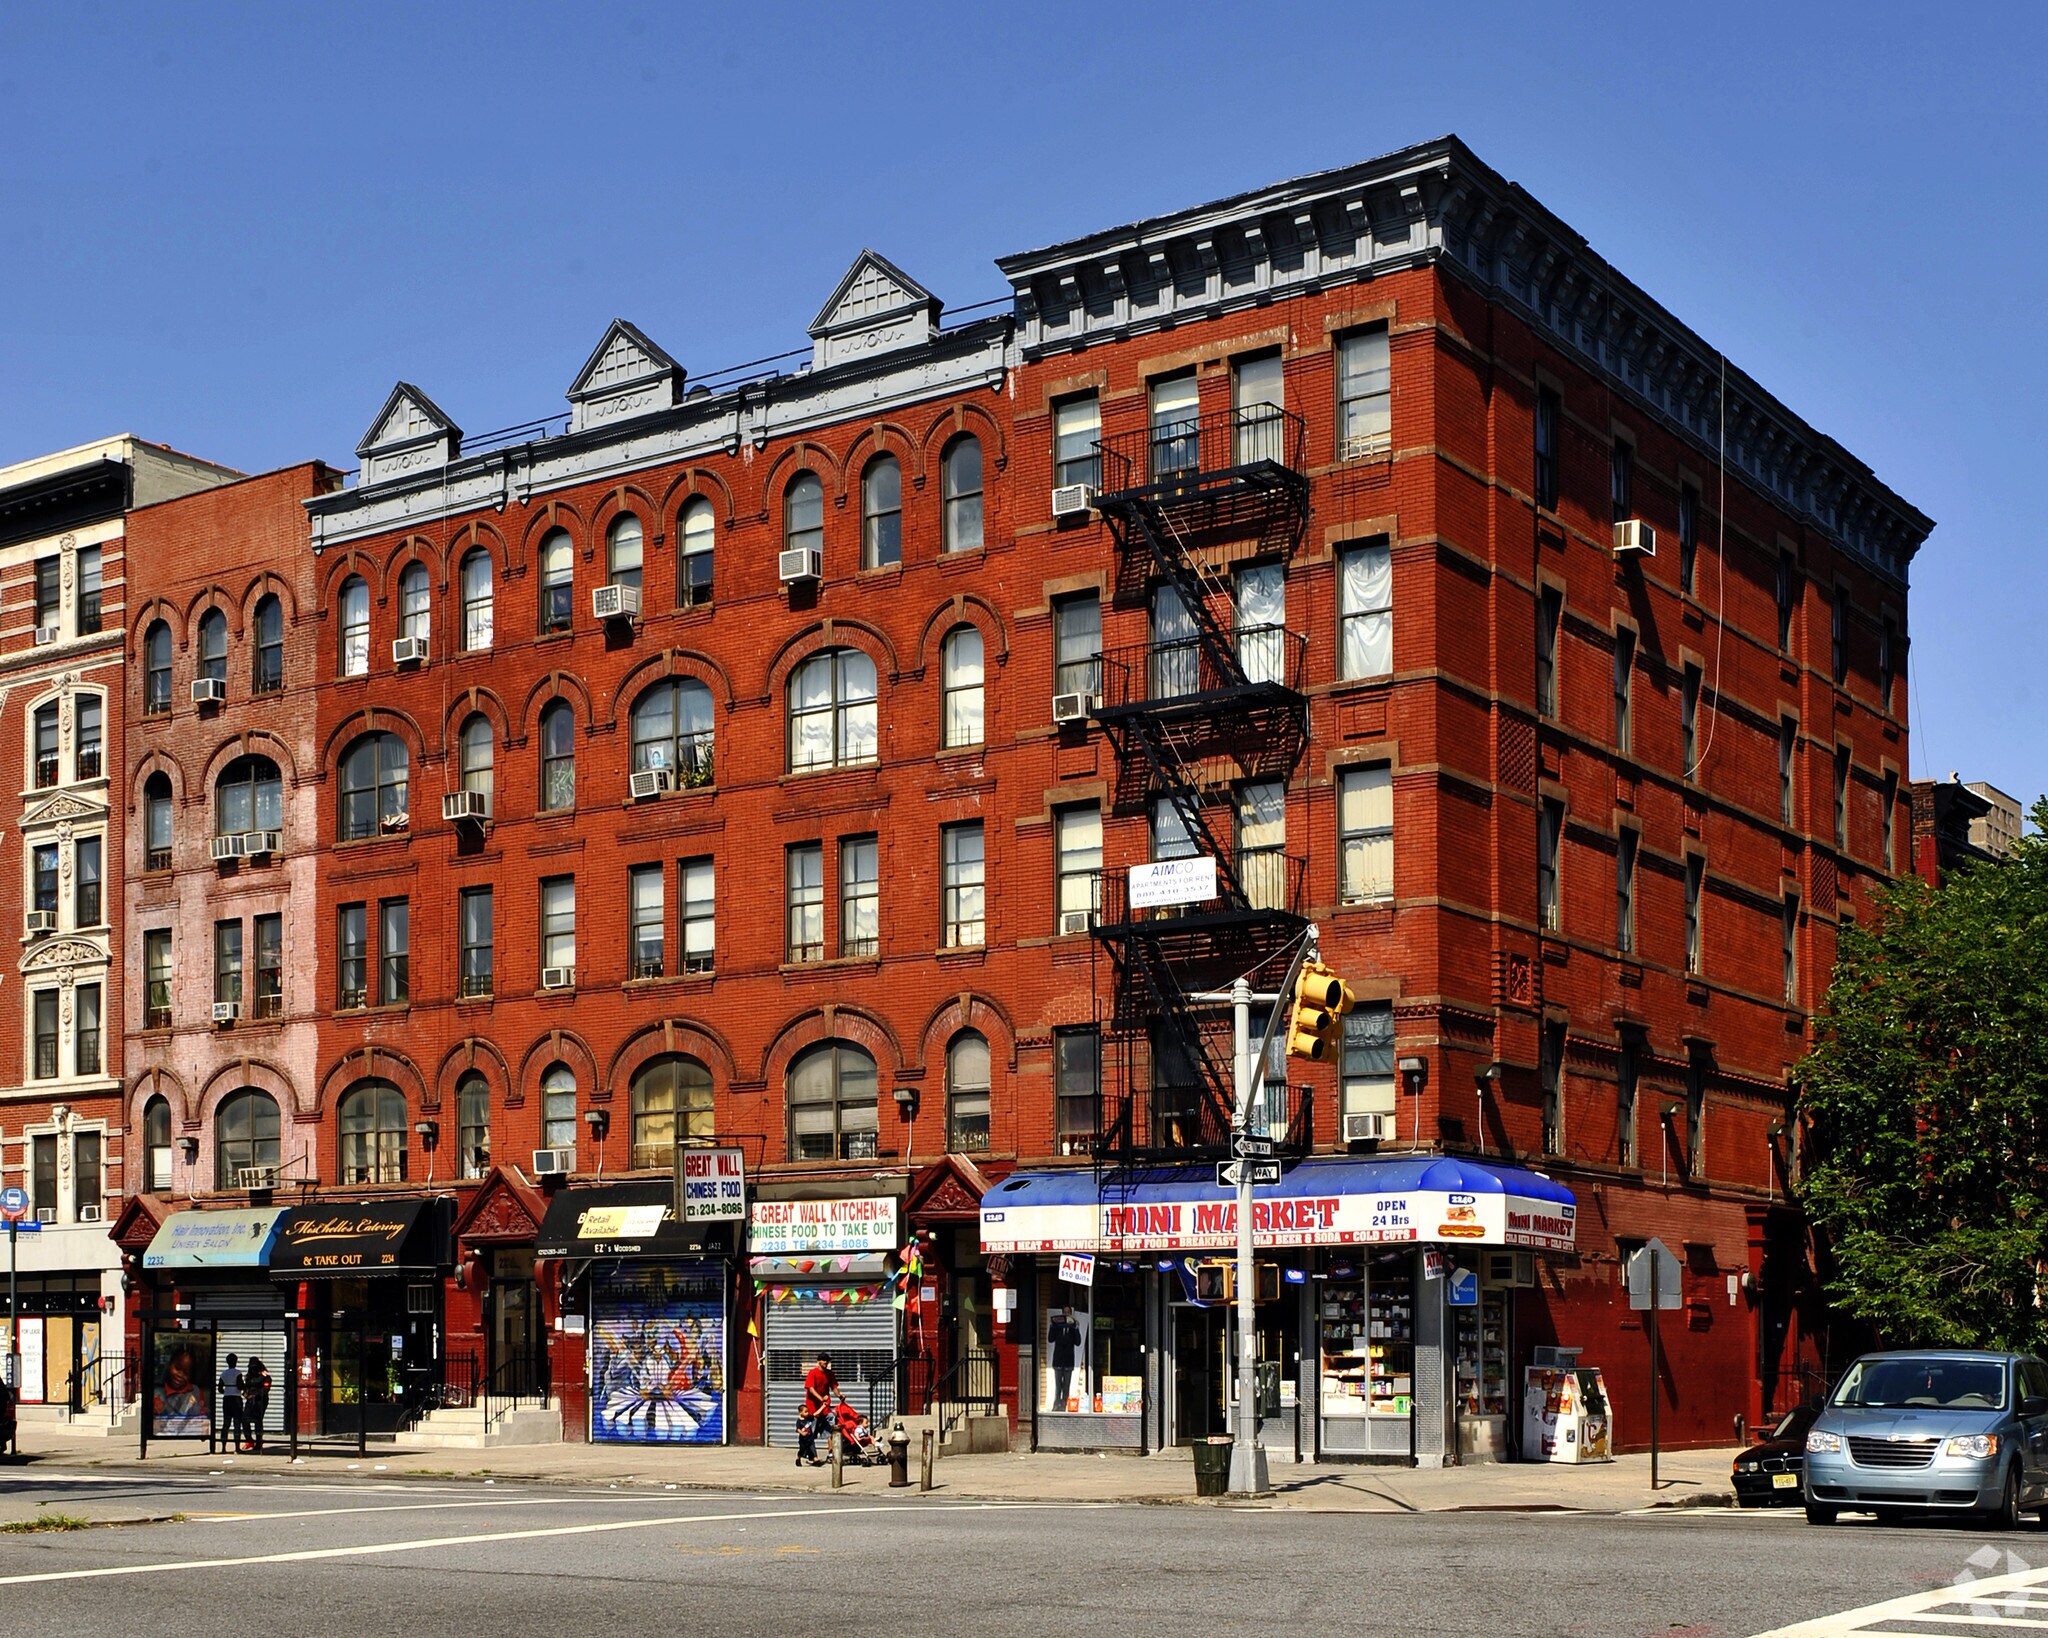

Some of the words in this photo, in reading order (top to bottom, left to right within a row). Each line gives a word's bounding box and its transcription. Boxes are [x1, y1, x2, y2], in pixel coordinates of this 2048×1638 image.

[1150, 861, 1194, 878] AIMCO
[1240, 1141, 1252, 1152] ONE
[1256, 1143, 1270, 1153] WAY
[685, 1155, 711, 1177] GREAT
[717, 1155, 740, 1176] WALL
[1254, 1168, 1274, 1178] WAY
[686, 1182, 717, 1199] CHINESE
[721, 1181, 741, 1198] FOOD
[1377, 1200, 1406, 1212] OPEN
[1450, 1195, 1474, 1205] 2240
[588, 1214, 611, 1224] Retail
[760, 1204, 794, 1224] GREAT
[800, 1203, 827, 1223] WALL
[830, 1201, 877, 1222] KITCHEN
[1106, 1205, 1182, 1236] MINI
[1193, 1198, 1340, 1234] MARKET
[1372, 1216, 1387, 1227] 24
[1391, 1214, 1410, 1226] Hrs
[1508, 1210, 1531, 1230] MINI
[1532, 1213, 1574, 1237] MARKET
[172, 1223, 189, 1237] Hair
[356, 1218, 405, 1241] Catering
[582, 1226, 619, 1235] Available
[747, 1225, 787, 1239] CHINESE
[791, 1224, 818, 1238] FOOD
[823, 1223, 837, 1237] TO
[842, 1222, 868, 1236] TAKE
[873, 1221, 894, 1235] OUT
[761, 1241, 787, 1251] 2238
[985, 1241, 1015, 1252] FRESH
[1016, 1240, 1043, 1251] MEAT
[1052, 1238, 1112, 1250] SANDWICHES
[1122, 1237, 1143, 1249] HOT
[1144, 1237, 1169, 1249] FOOD
[1179, 1235, 1237, 1247] BREAKFAST
[1252, 1233, 1273, 1246] OLD
[1275, 1232, 1302, 1244] BEER
[1304, 1232, 1313, 1244] &
[1314, 1231, 1342, 1243] SODA
[1352, 1230, 1380, 1242] COLD
[1382, 1228, 1411, 1240] CUTS
[147, 1256, 165, 1266] 2232
[303, 1255, 313, 1266] &
[314, 1255, 339, 1265] TAKE
[341, 1254, 363, 1265] OUT
[381, 1254, 395, 1264] 2234
[1062, 1257, 1092, 1275] ATM
[1061, 1270, 1074, 1279] $10
